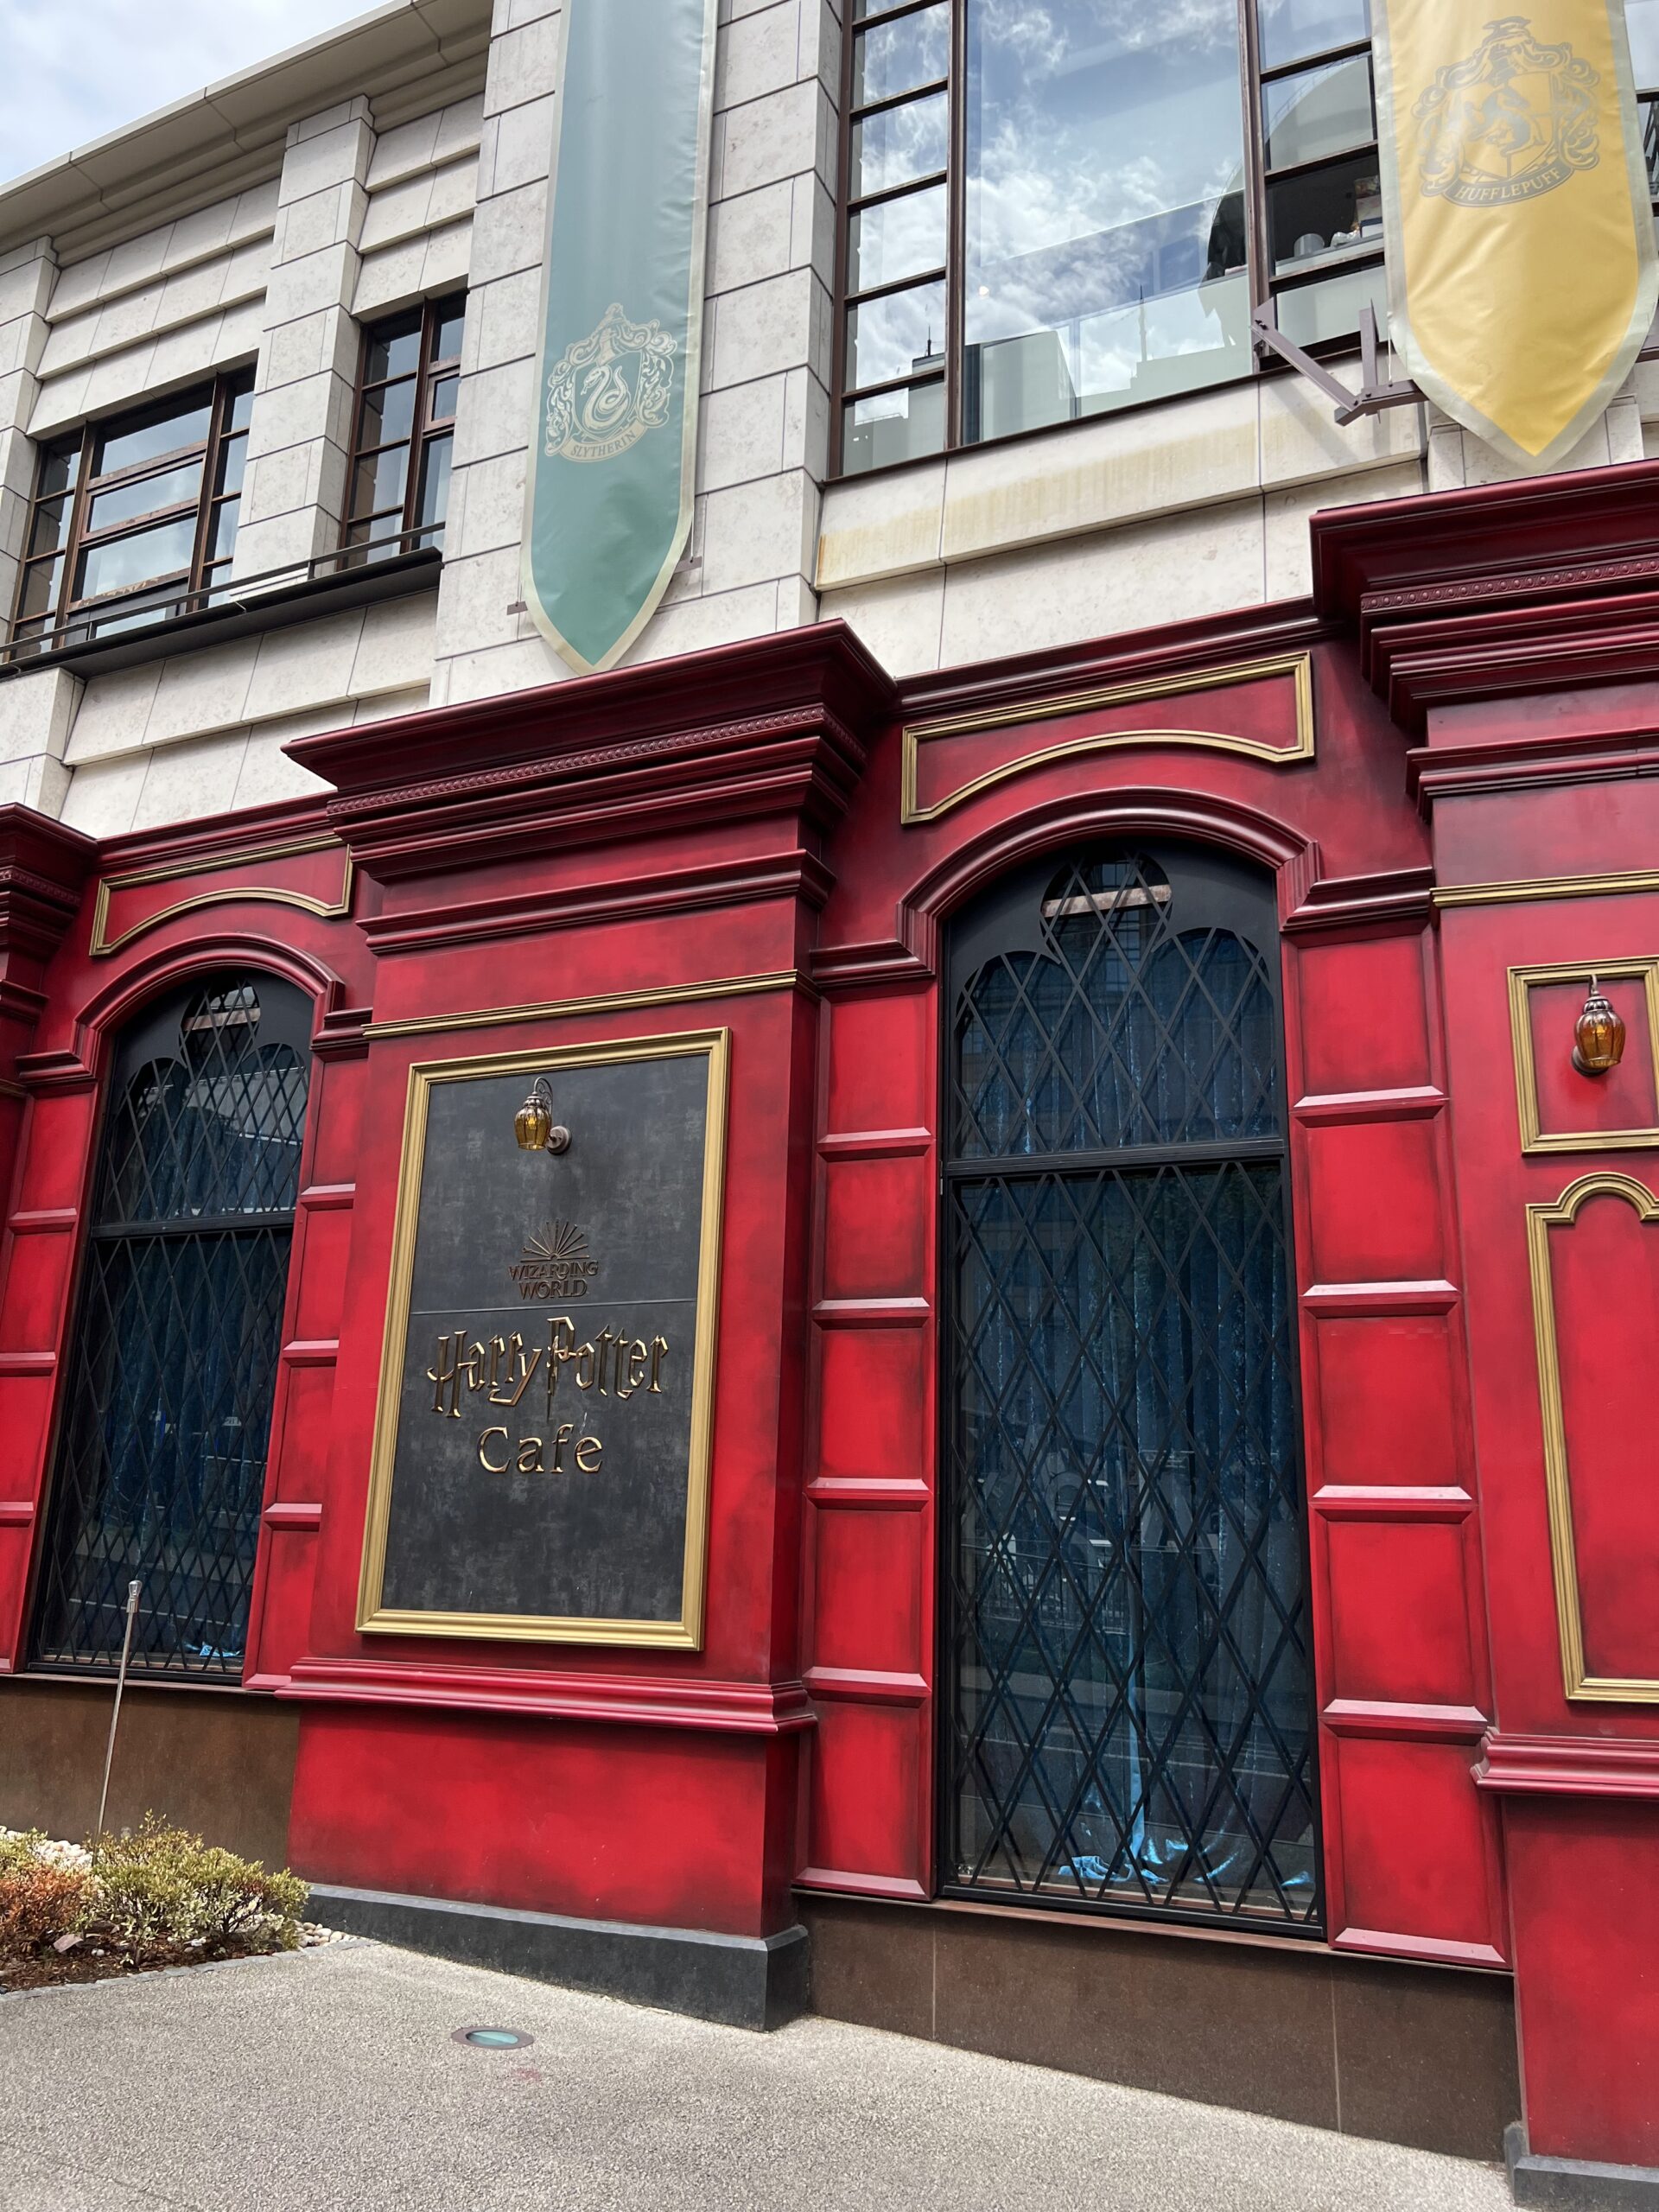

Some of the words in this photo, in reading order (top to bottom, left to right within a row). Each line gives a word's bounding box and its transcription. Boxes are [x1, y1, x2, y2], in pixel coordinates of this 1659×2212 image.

[1454, 167, 1562, 200] HUFFLEPUFF
[570, 430, 636, 457] SLYTHERIN
[508, 1261, 598, 1281] WIZARDING
[518, 1279, 588, 1300] WORLD
[427, 1331, 543, 1418] Harry
[546, 1316, 669, 1422] Potter
[479, 1423, 603, 1474] Cafe
